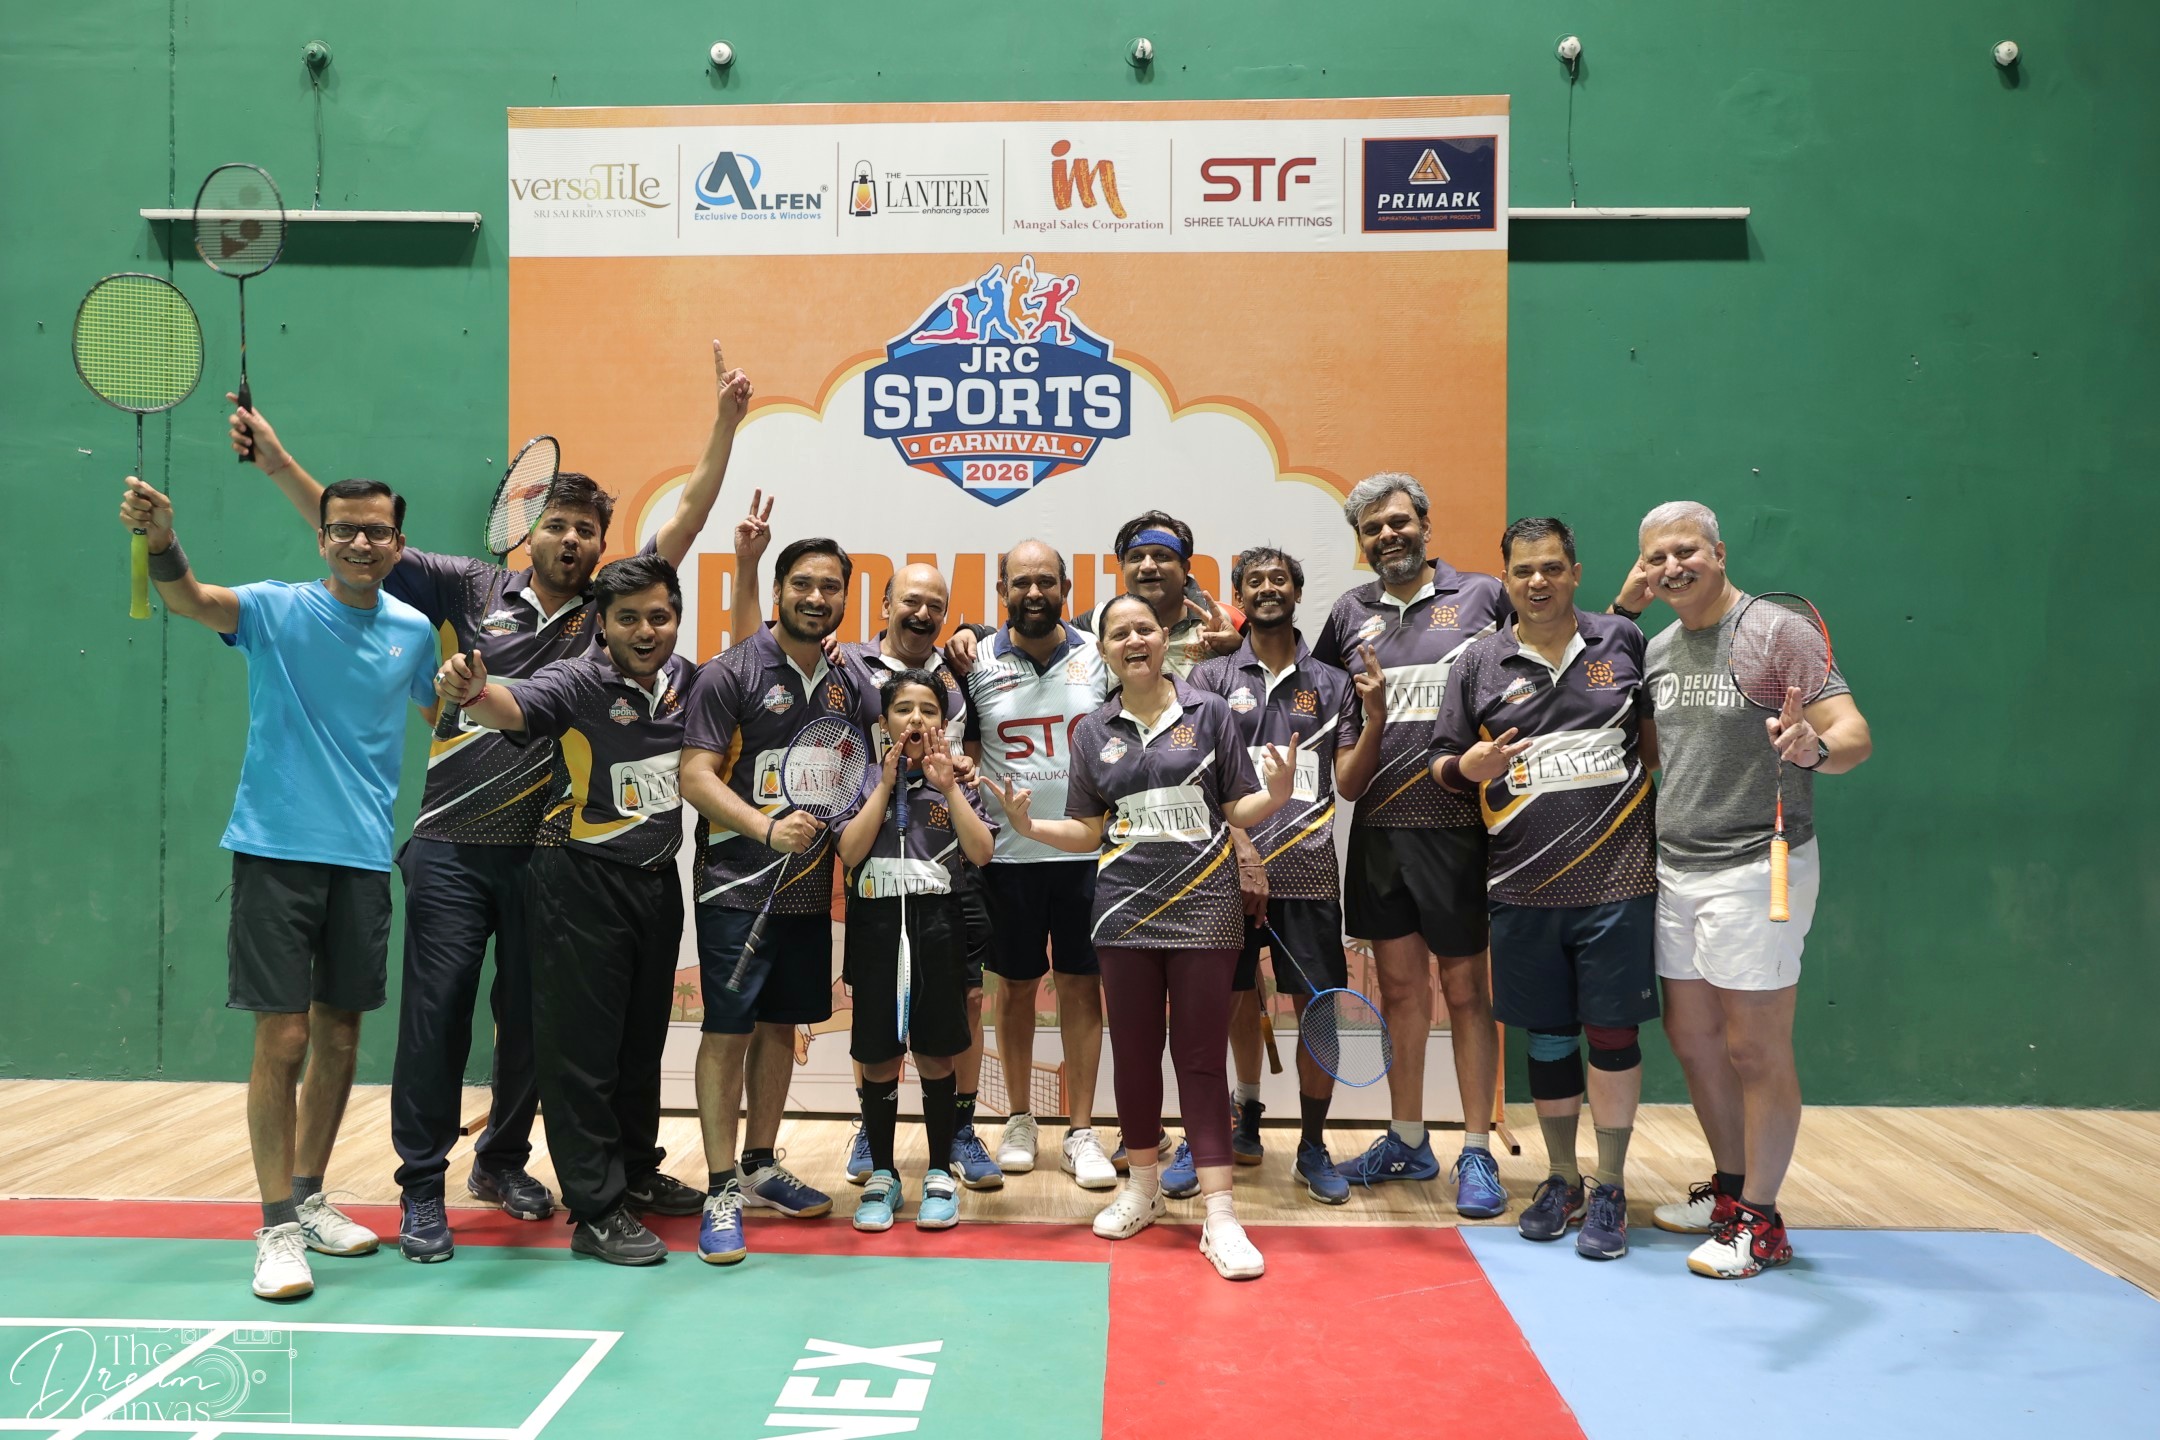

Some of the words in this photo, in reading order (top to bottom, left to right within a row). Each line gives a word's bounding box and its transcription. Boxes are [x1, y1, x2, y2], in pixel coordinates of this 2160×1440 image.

[695, 151, 822, 210] ALFEN
[1200, 157, 1317, 202] STF
[885, 179, 990, 208] LANTERN
[1377, 191, 1481, 209] PRIMARK
[534, 209, 550, 218] SRI
[553, 209, 569, 218] SAI
[572, 209, 603, 218] KRIPA
[606, 209, 646, 218] STONES
[694, 212, 738, 221] Exclusive
[740, 212, 768, 220] Doors
[780, 212, 822, 220] Windows
[922, 206, 961, 216] enhancing
[963, 206, 990, 216] spaces
[1378, 214, 1419, 222] ASPIRATIONAL
[1449, 213, 1482, 221] PRODUCTS
[1013, 219, 1057, 233] Mangal
[1060, 219, 1089, 230] Sales
[1092, 219, 1164, 233] Corporation
[1184, 216, 1225, 228] SHREE
[1227, 216, 1275, 228] TALUKA
[1277, 216, 1333, 227] FITTINGS
[959, 346, 1041, 374] JRC
[873, 373, 1122, 431] SPORTS
[928, 433, 1066, 455] CARNIVAL
[965, 463, 1029, 482] 2026
[1683, 673, 1740, 691] DEVILS
[1386, 685, 1447, 711] ANTER
[1681, 690, 1749, 708] CIRCUIT
[1024, 770, 1070, 781] TALUKA
